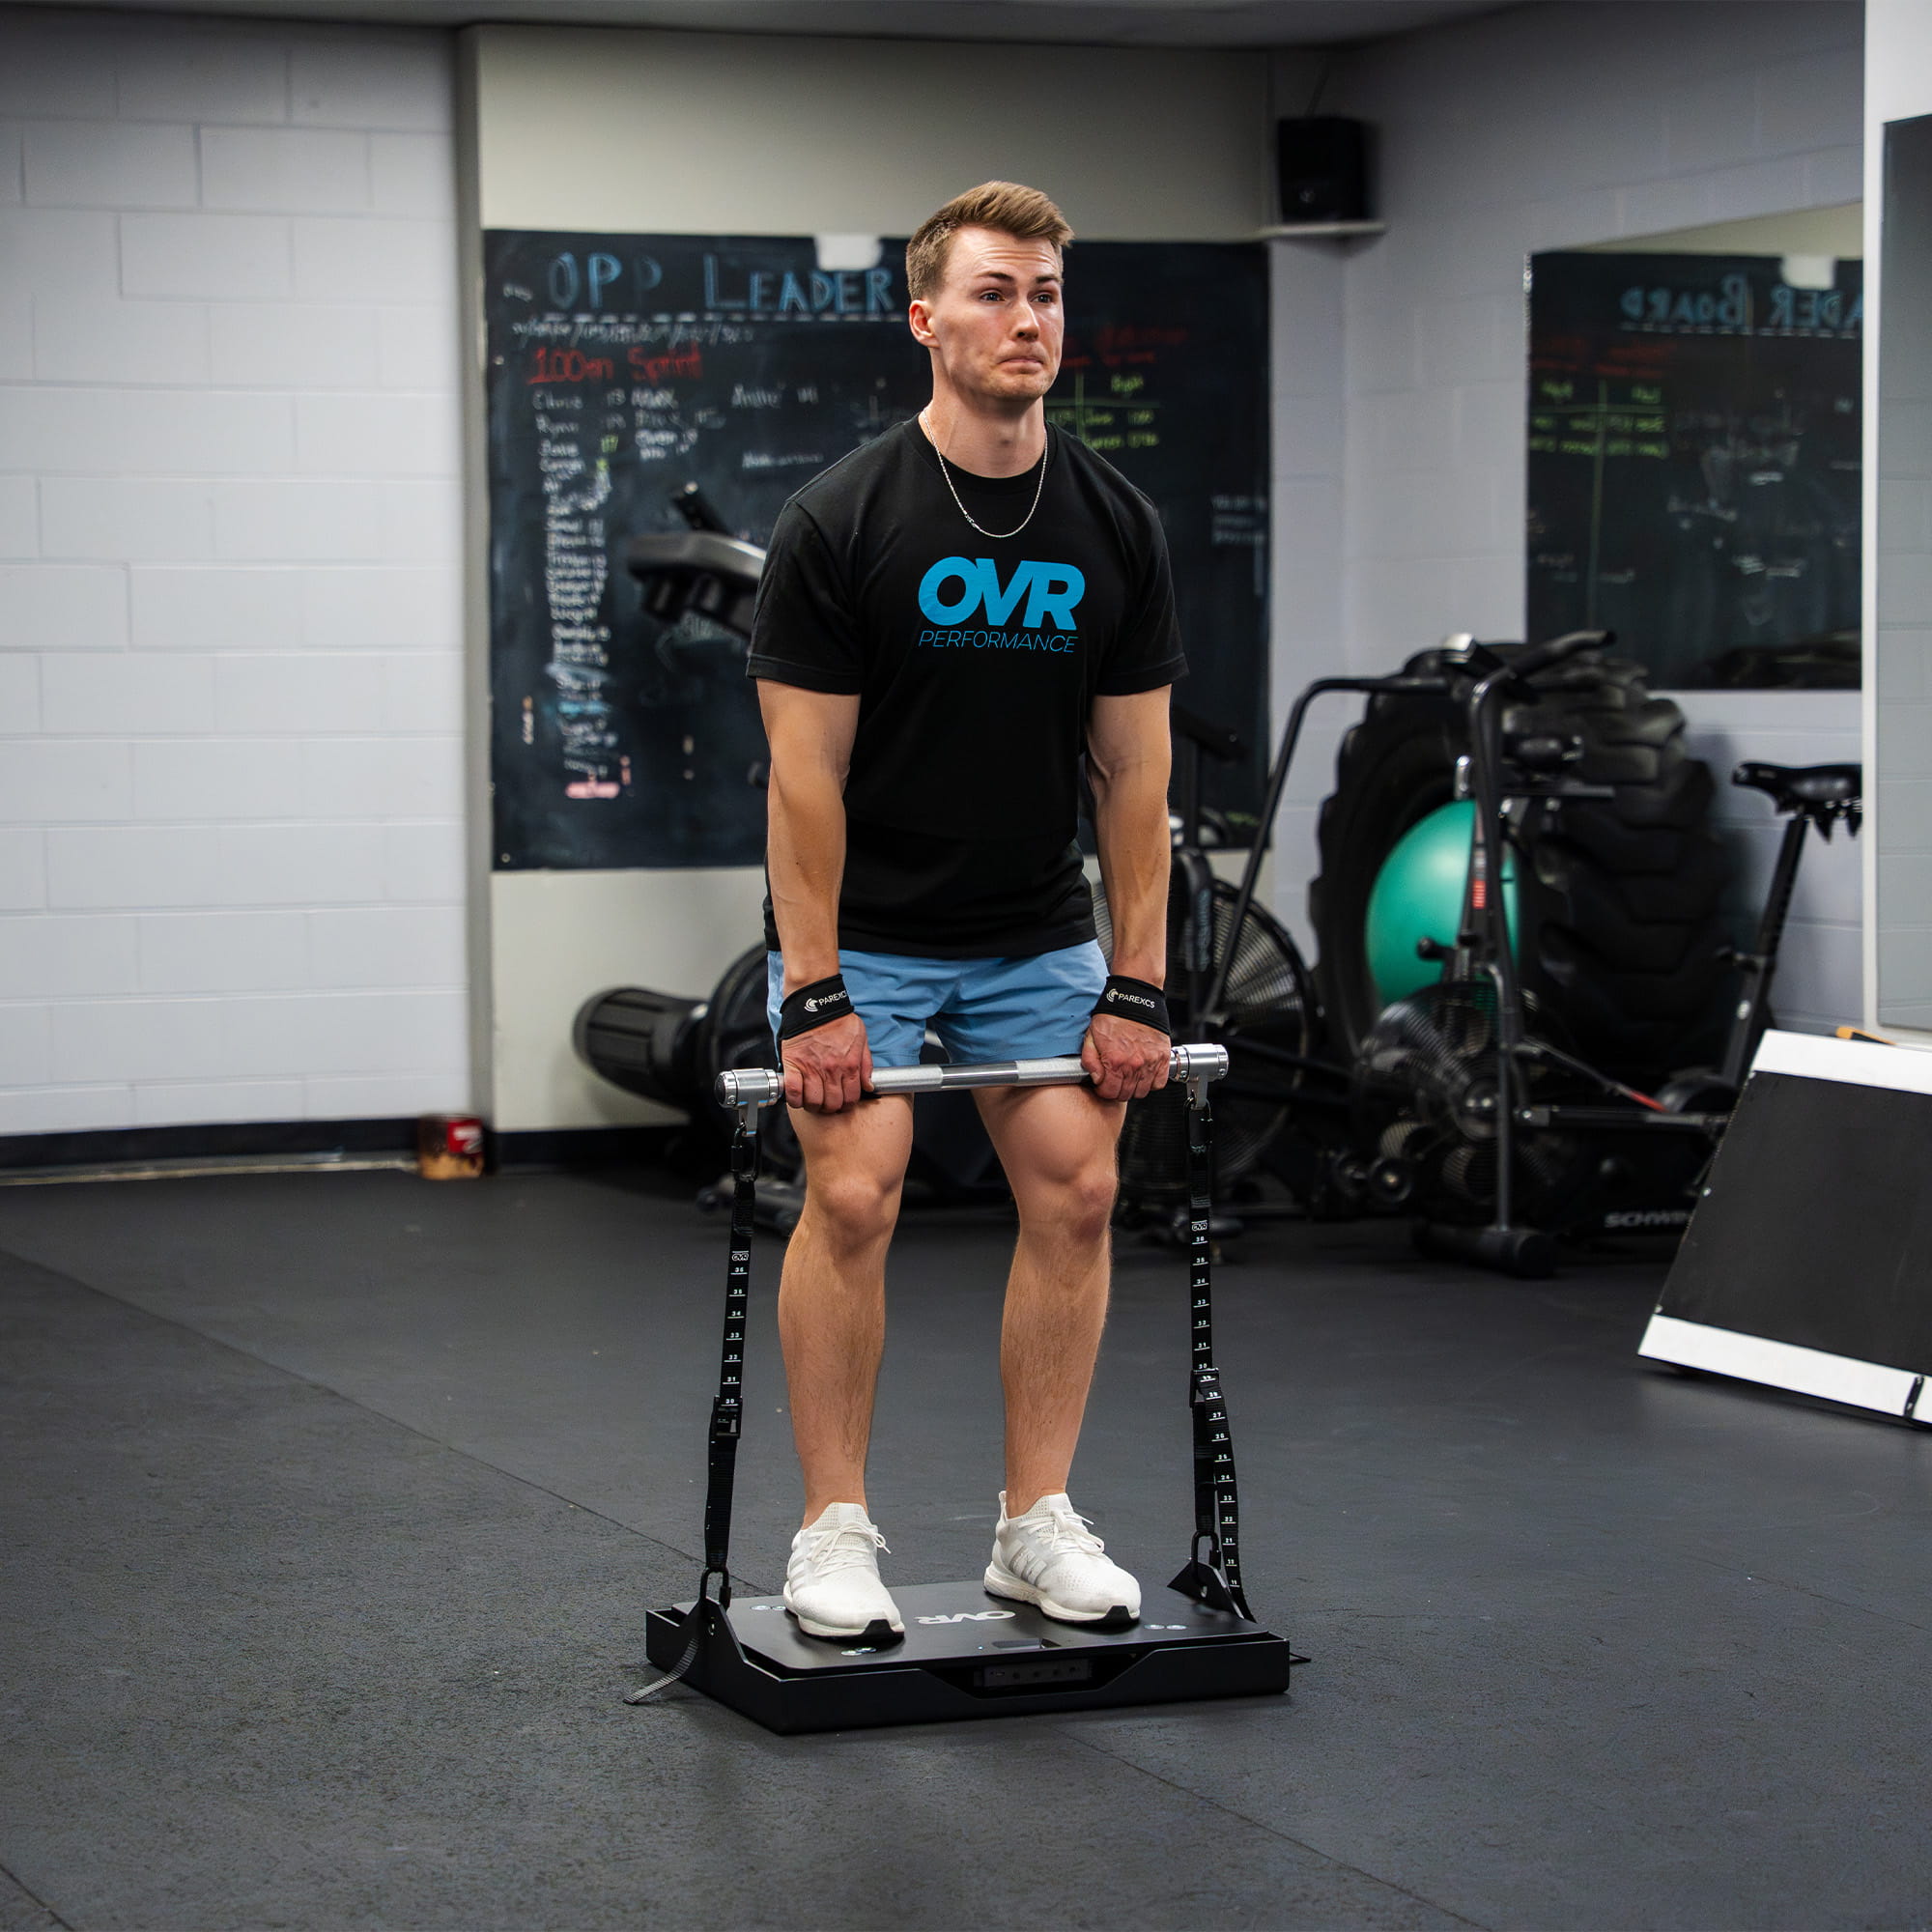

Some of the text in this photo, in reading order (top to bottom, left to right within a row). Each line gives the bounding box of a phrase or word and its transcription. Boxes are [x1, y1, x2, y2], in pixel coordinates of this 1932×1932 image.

[705, 254, 893, 313] LEADER
[528, 347, 615, 385] 100m
[919, 556, 1086, 631] OVR
[919, 630, 1079, 653] PERFORMANCE
[818, 990, 849, 1006] PAREXC
[1118, 993, 1155, 1009] PAREXCS
[914, 1610, 1016, 1625] OVR
